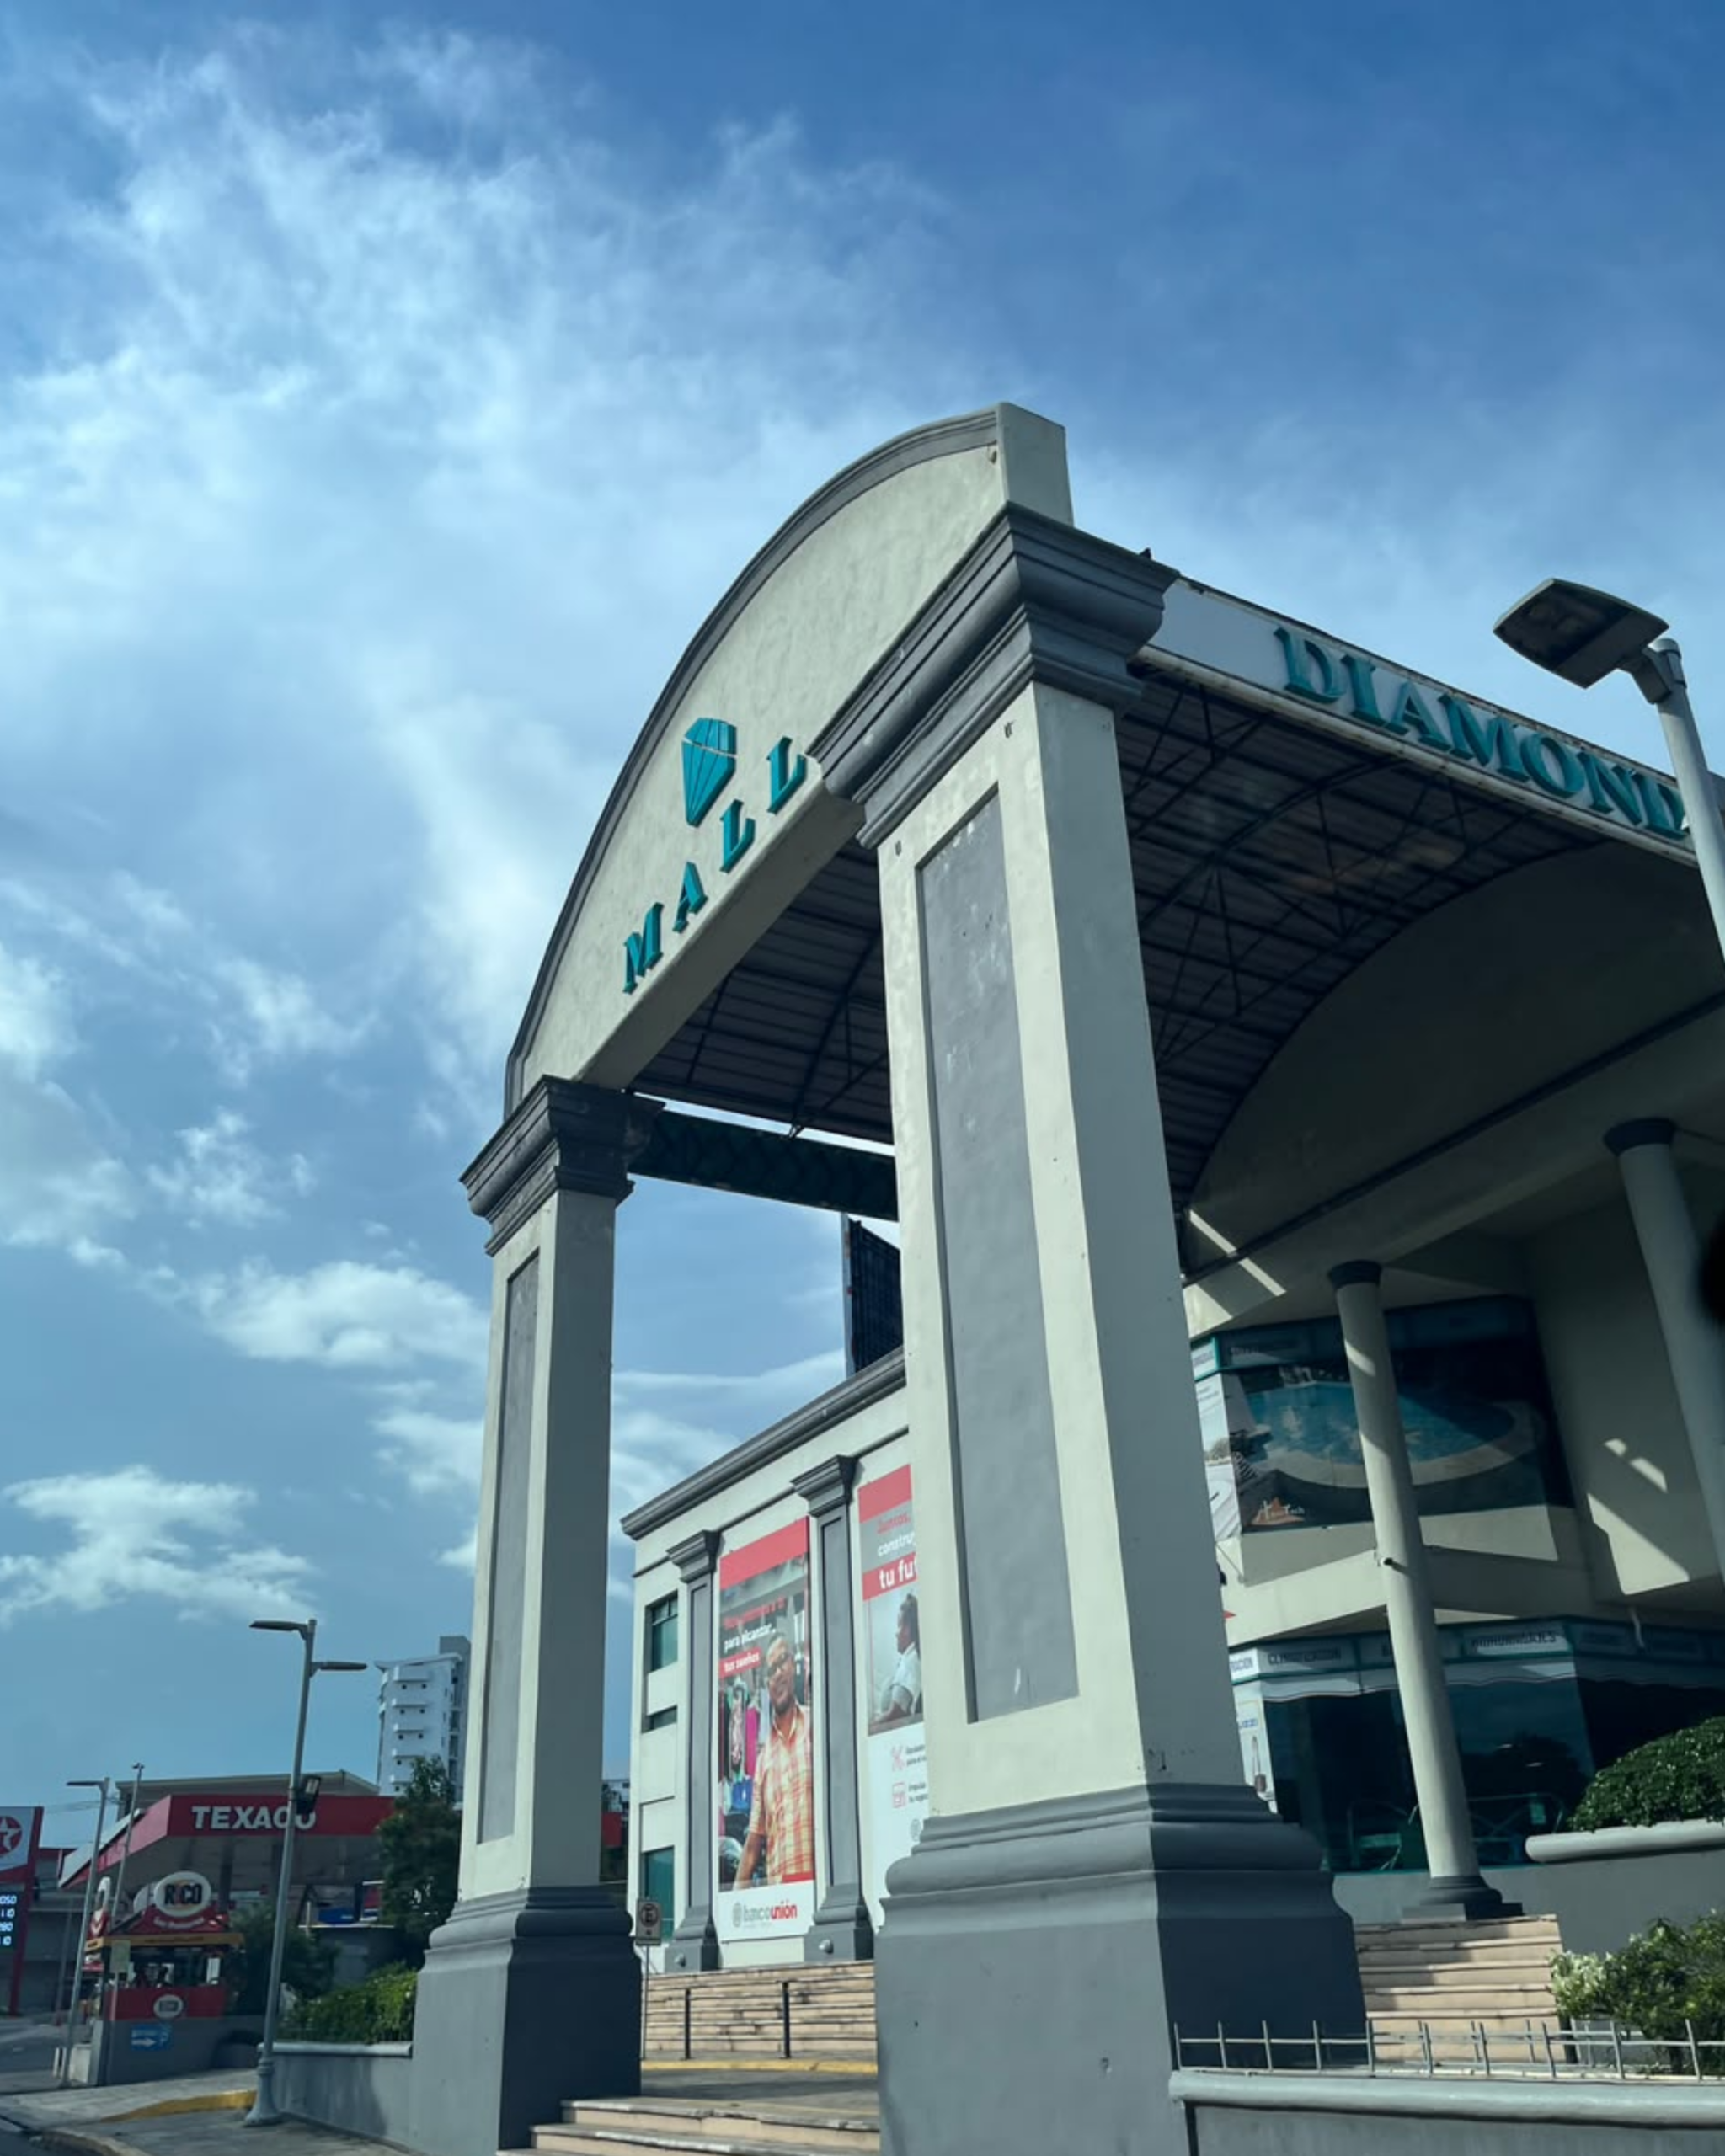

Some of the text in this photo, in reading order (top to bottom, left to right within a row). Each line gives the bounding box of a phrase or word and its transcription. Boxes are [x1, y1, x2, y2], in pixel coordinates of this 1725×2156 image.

[1273, 626, 1690, 840] DIAMOND
[623, 736, 808, 995] MALL
[879, 1569, 895, 1590] tu
